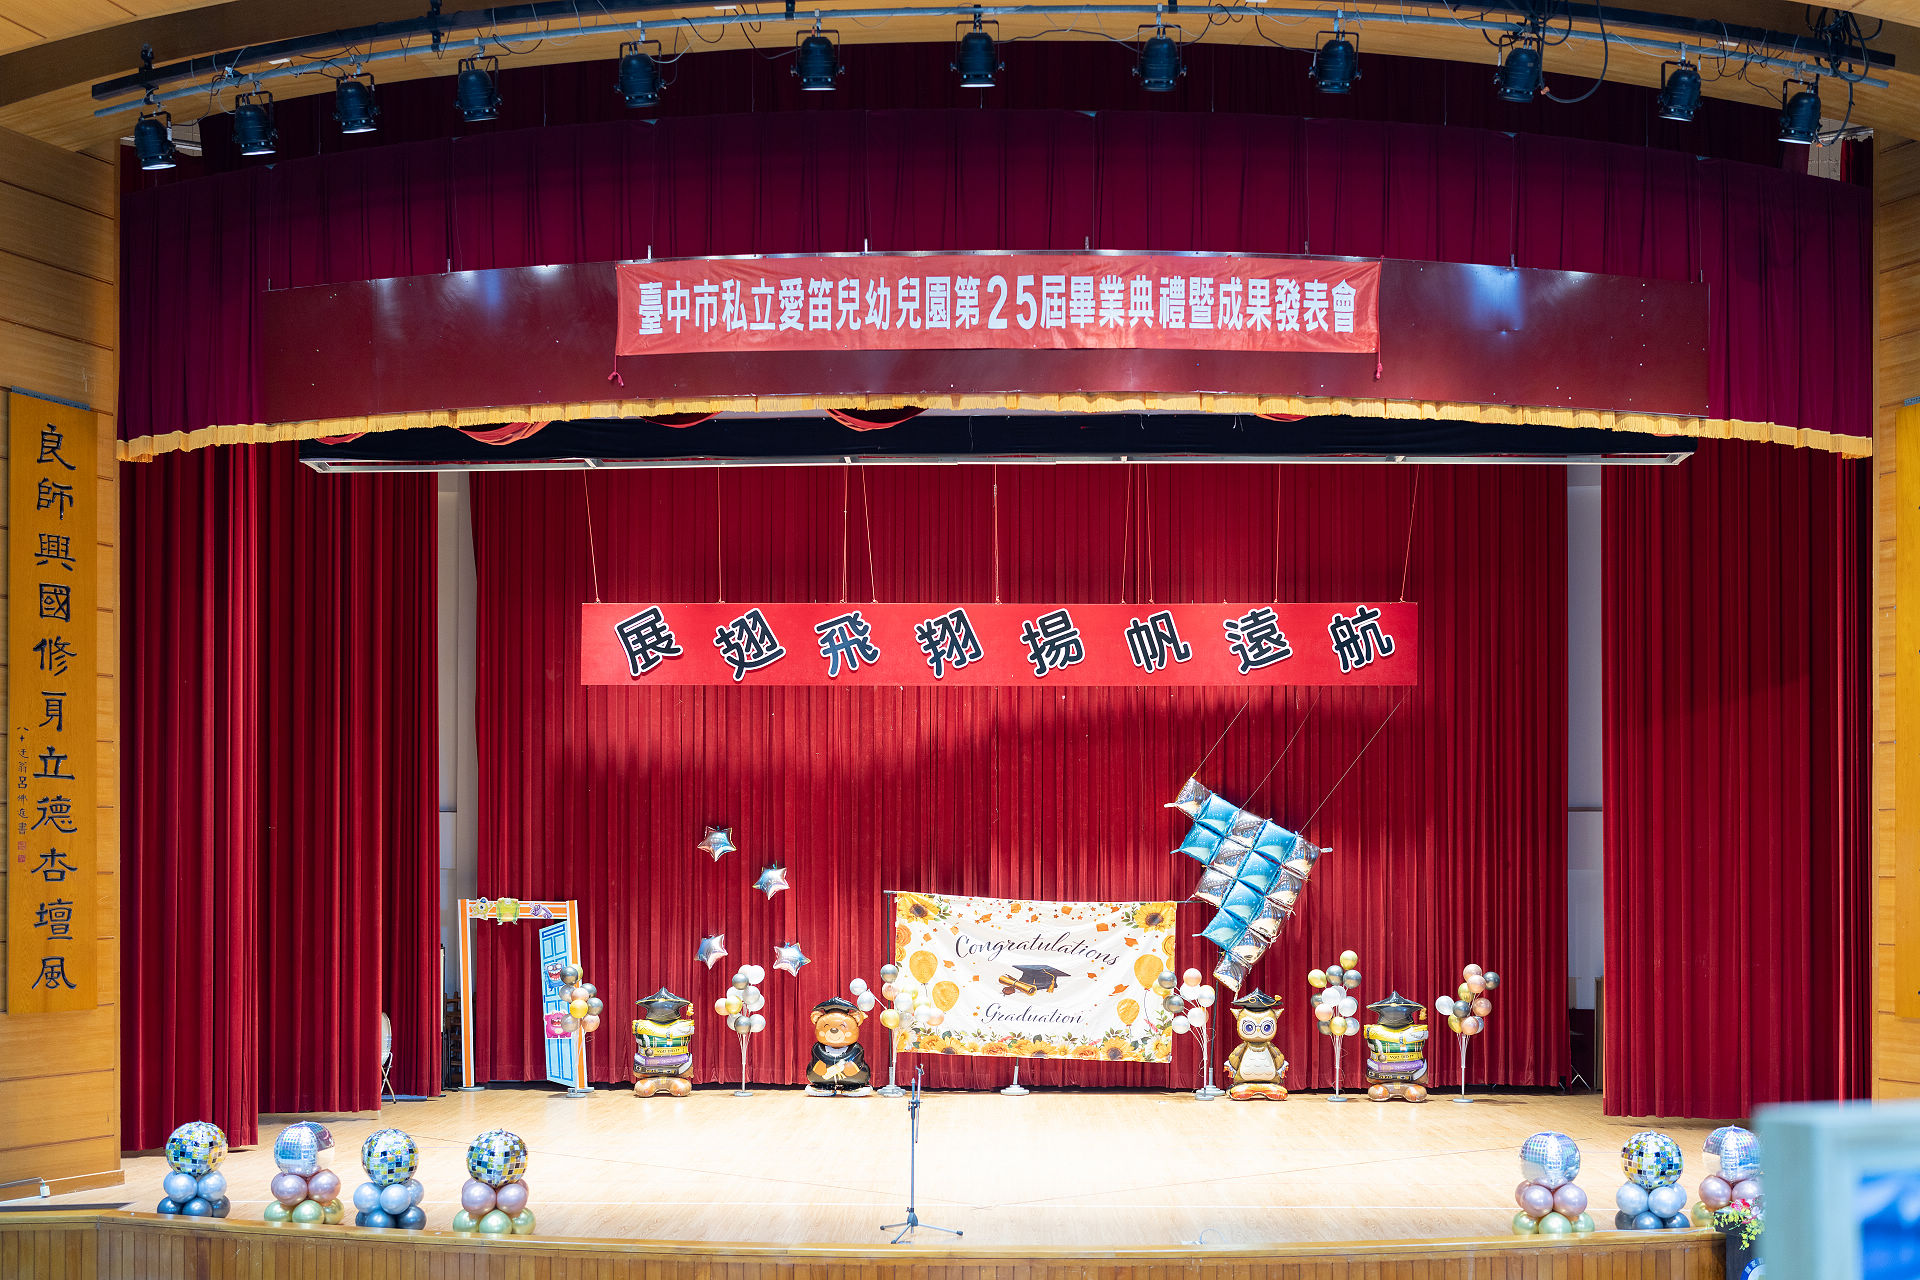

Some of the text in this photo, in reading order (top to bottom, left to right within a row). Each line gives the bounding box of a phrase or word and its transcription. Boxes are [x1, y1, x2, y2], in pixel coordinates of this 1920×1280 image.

[614, 605, 1395, 681] 展翅飛翔揚帆遠航
[31, 424, 77, 989] 良師興國修身立德杏壇風
[955, 932, 1120, 966] Congratulations
[982, 1003, 1083, 1025] Graduation
